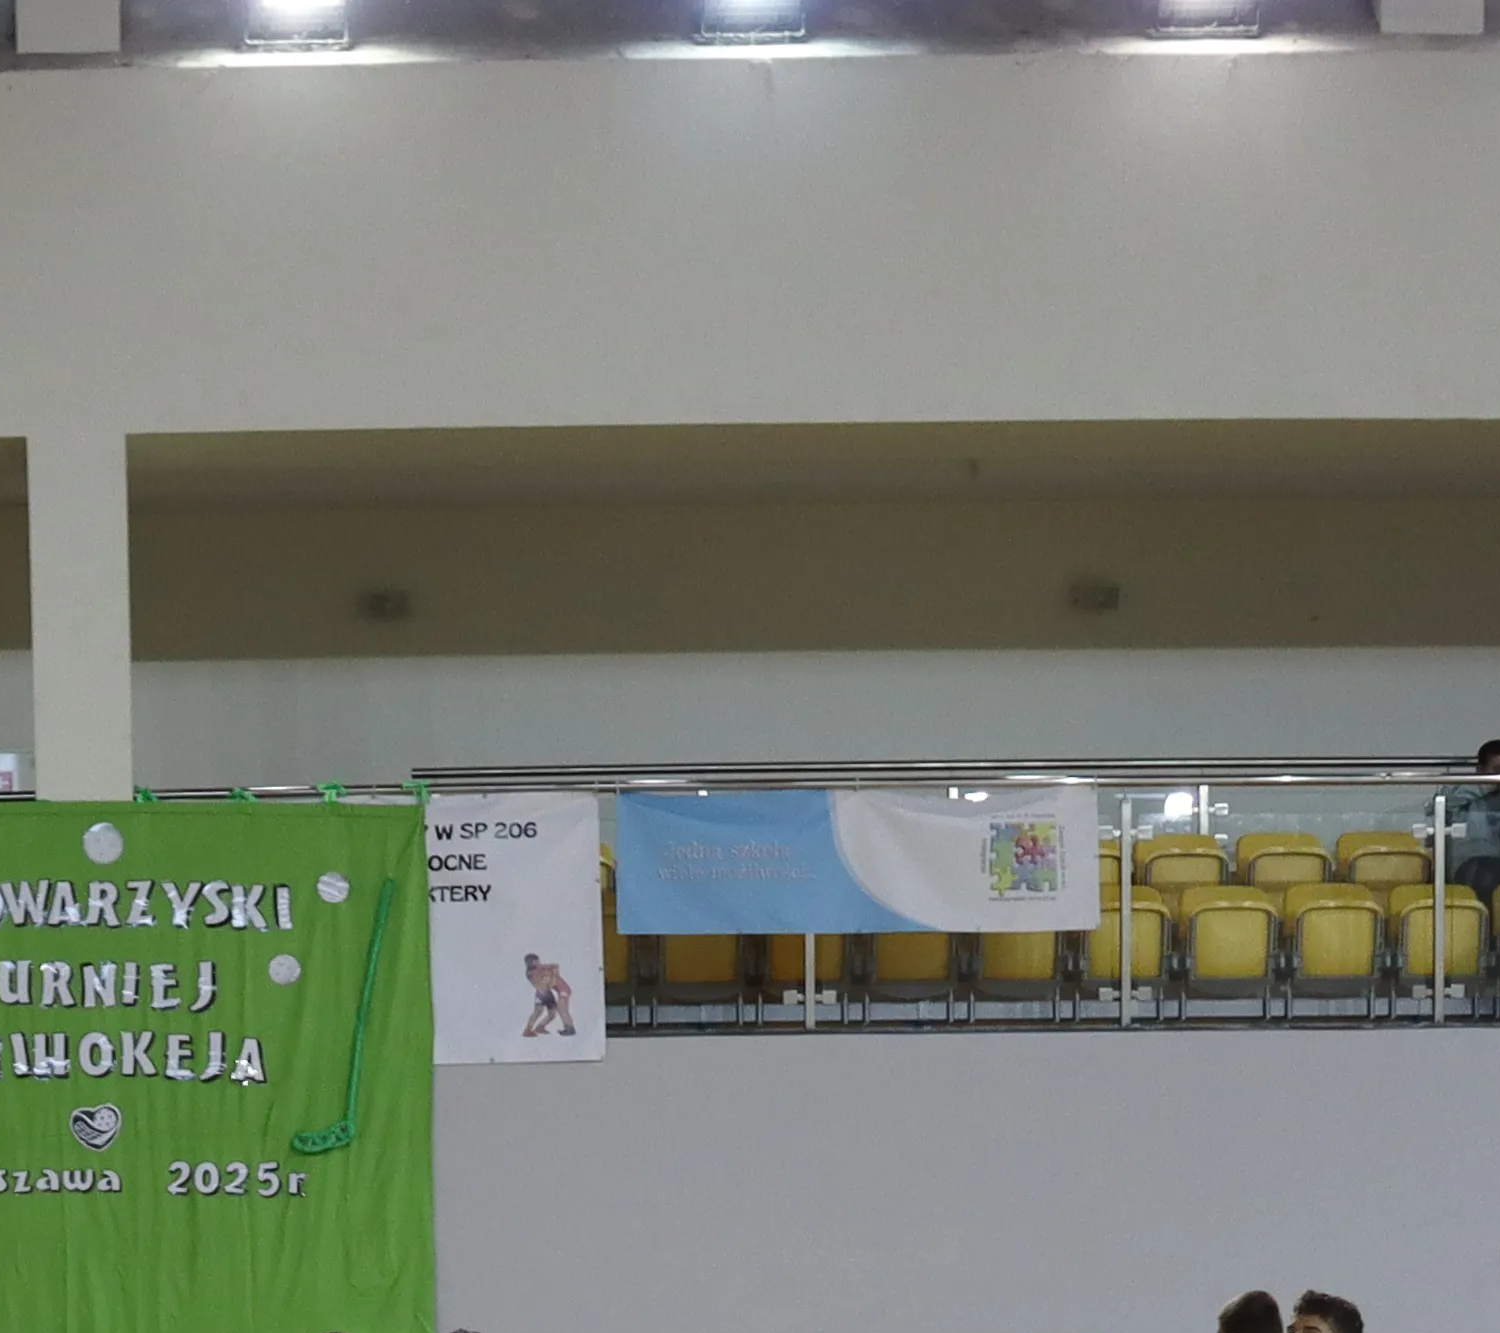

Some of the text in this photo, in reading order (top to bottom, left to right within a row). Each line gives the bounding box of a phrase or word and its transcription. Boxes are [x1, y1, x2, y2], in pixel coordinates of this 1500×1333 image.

[434, 822, 537, 840] W SP 206
[428, 854, 487, 871] OCNE
